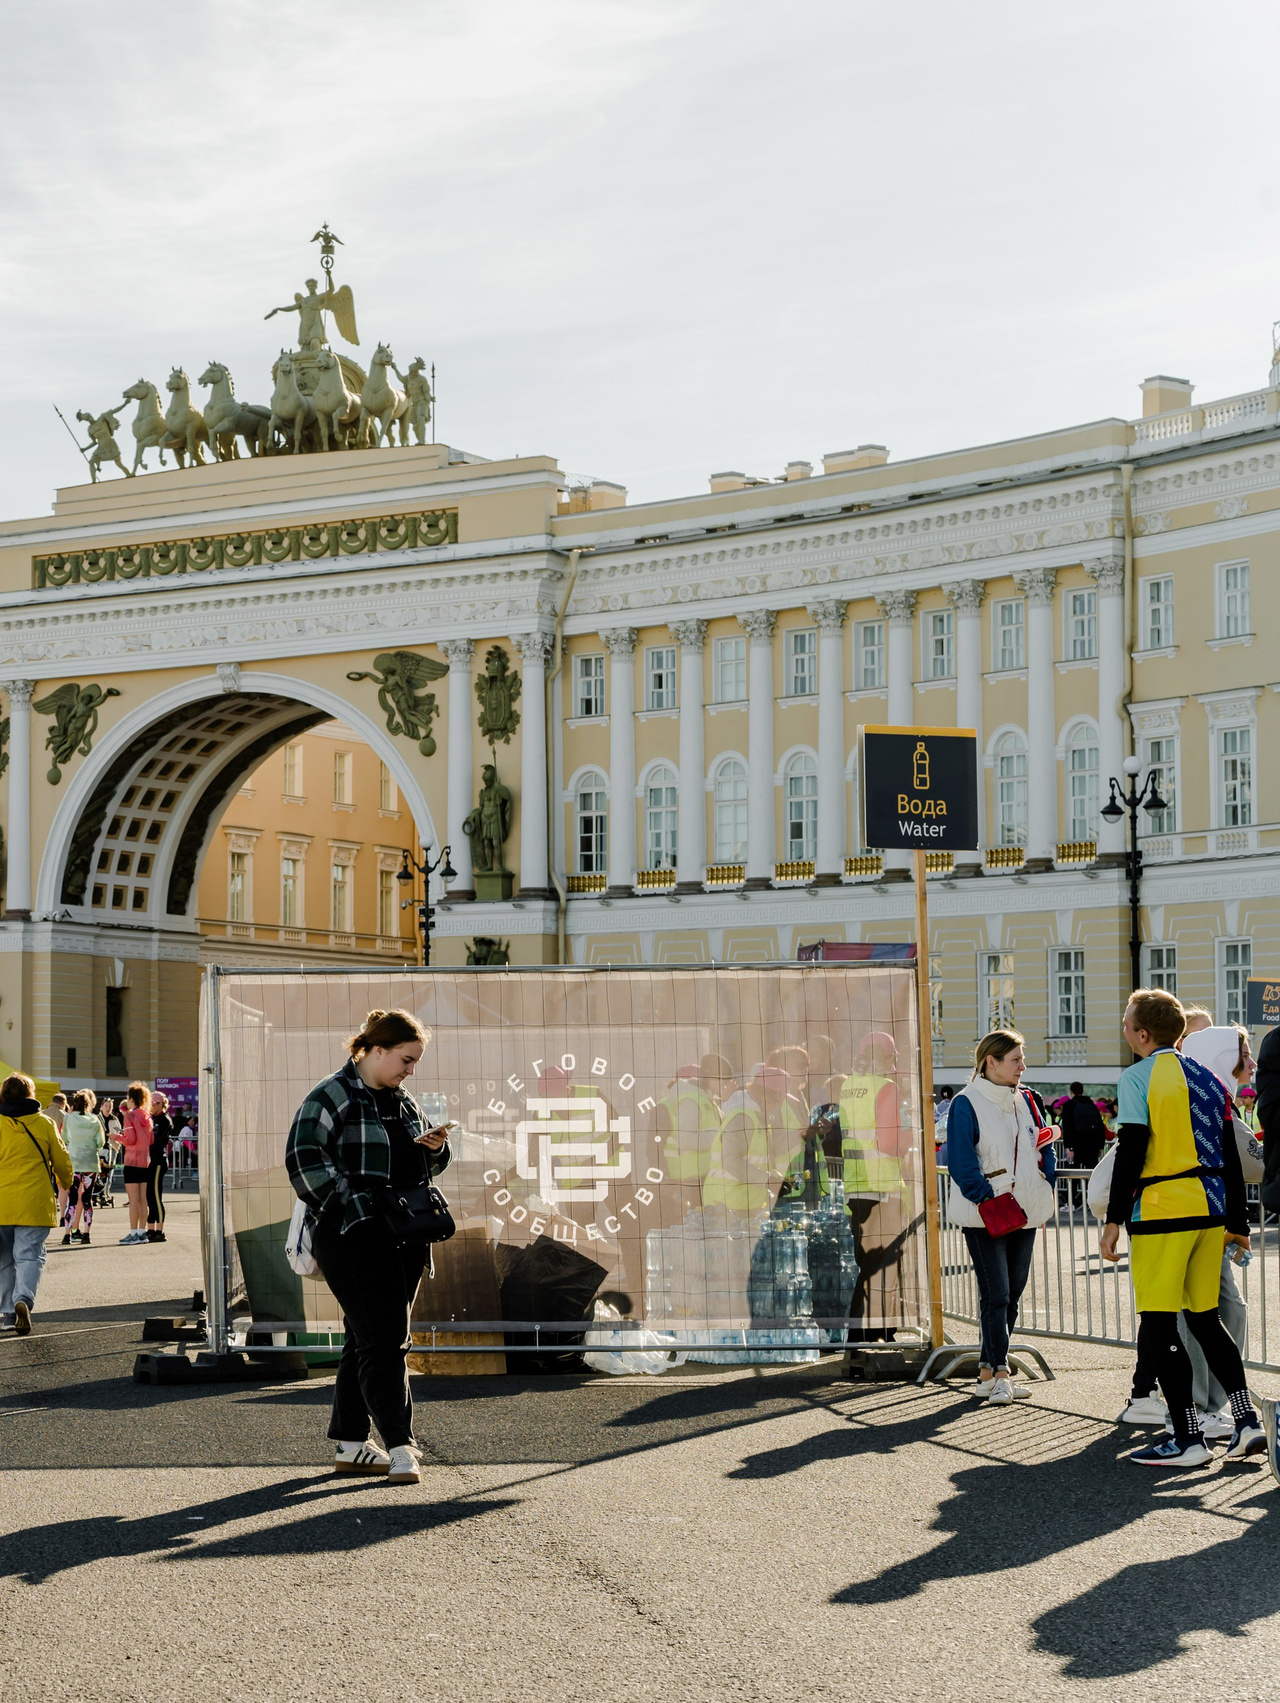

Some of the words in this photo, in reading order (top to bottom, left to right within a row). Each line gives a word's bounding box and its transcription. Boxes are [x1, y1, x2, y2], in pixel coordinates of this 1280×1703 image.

[897, 794, 947, 818] Вода
[898, 820, 946, 837] Water
[1262, 1003, 1280, 1014] Еда
[1262, 1013, 1280, 1022] Food
[486, 1053, 656, 1116] БЕГОВОЕ
[1187, 1077, 1211, 1101] Yandex
[1190, 1102, 1212, 1128] Yandex
[1193, 1129, 1216, 1155] Yandex
[483, 1166, 664, 1246] СООБЩЕСТВО
[1206, 1188, 1225, 1213] Yandex
